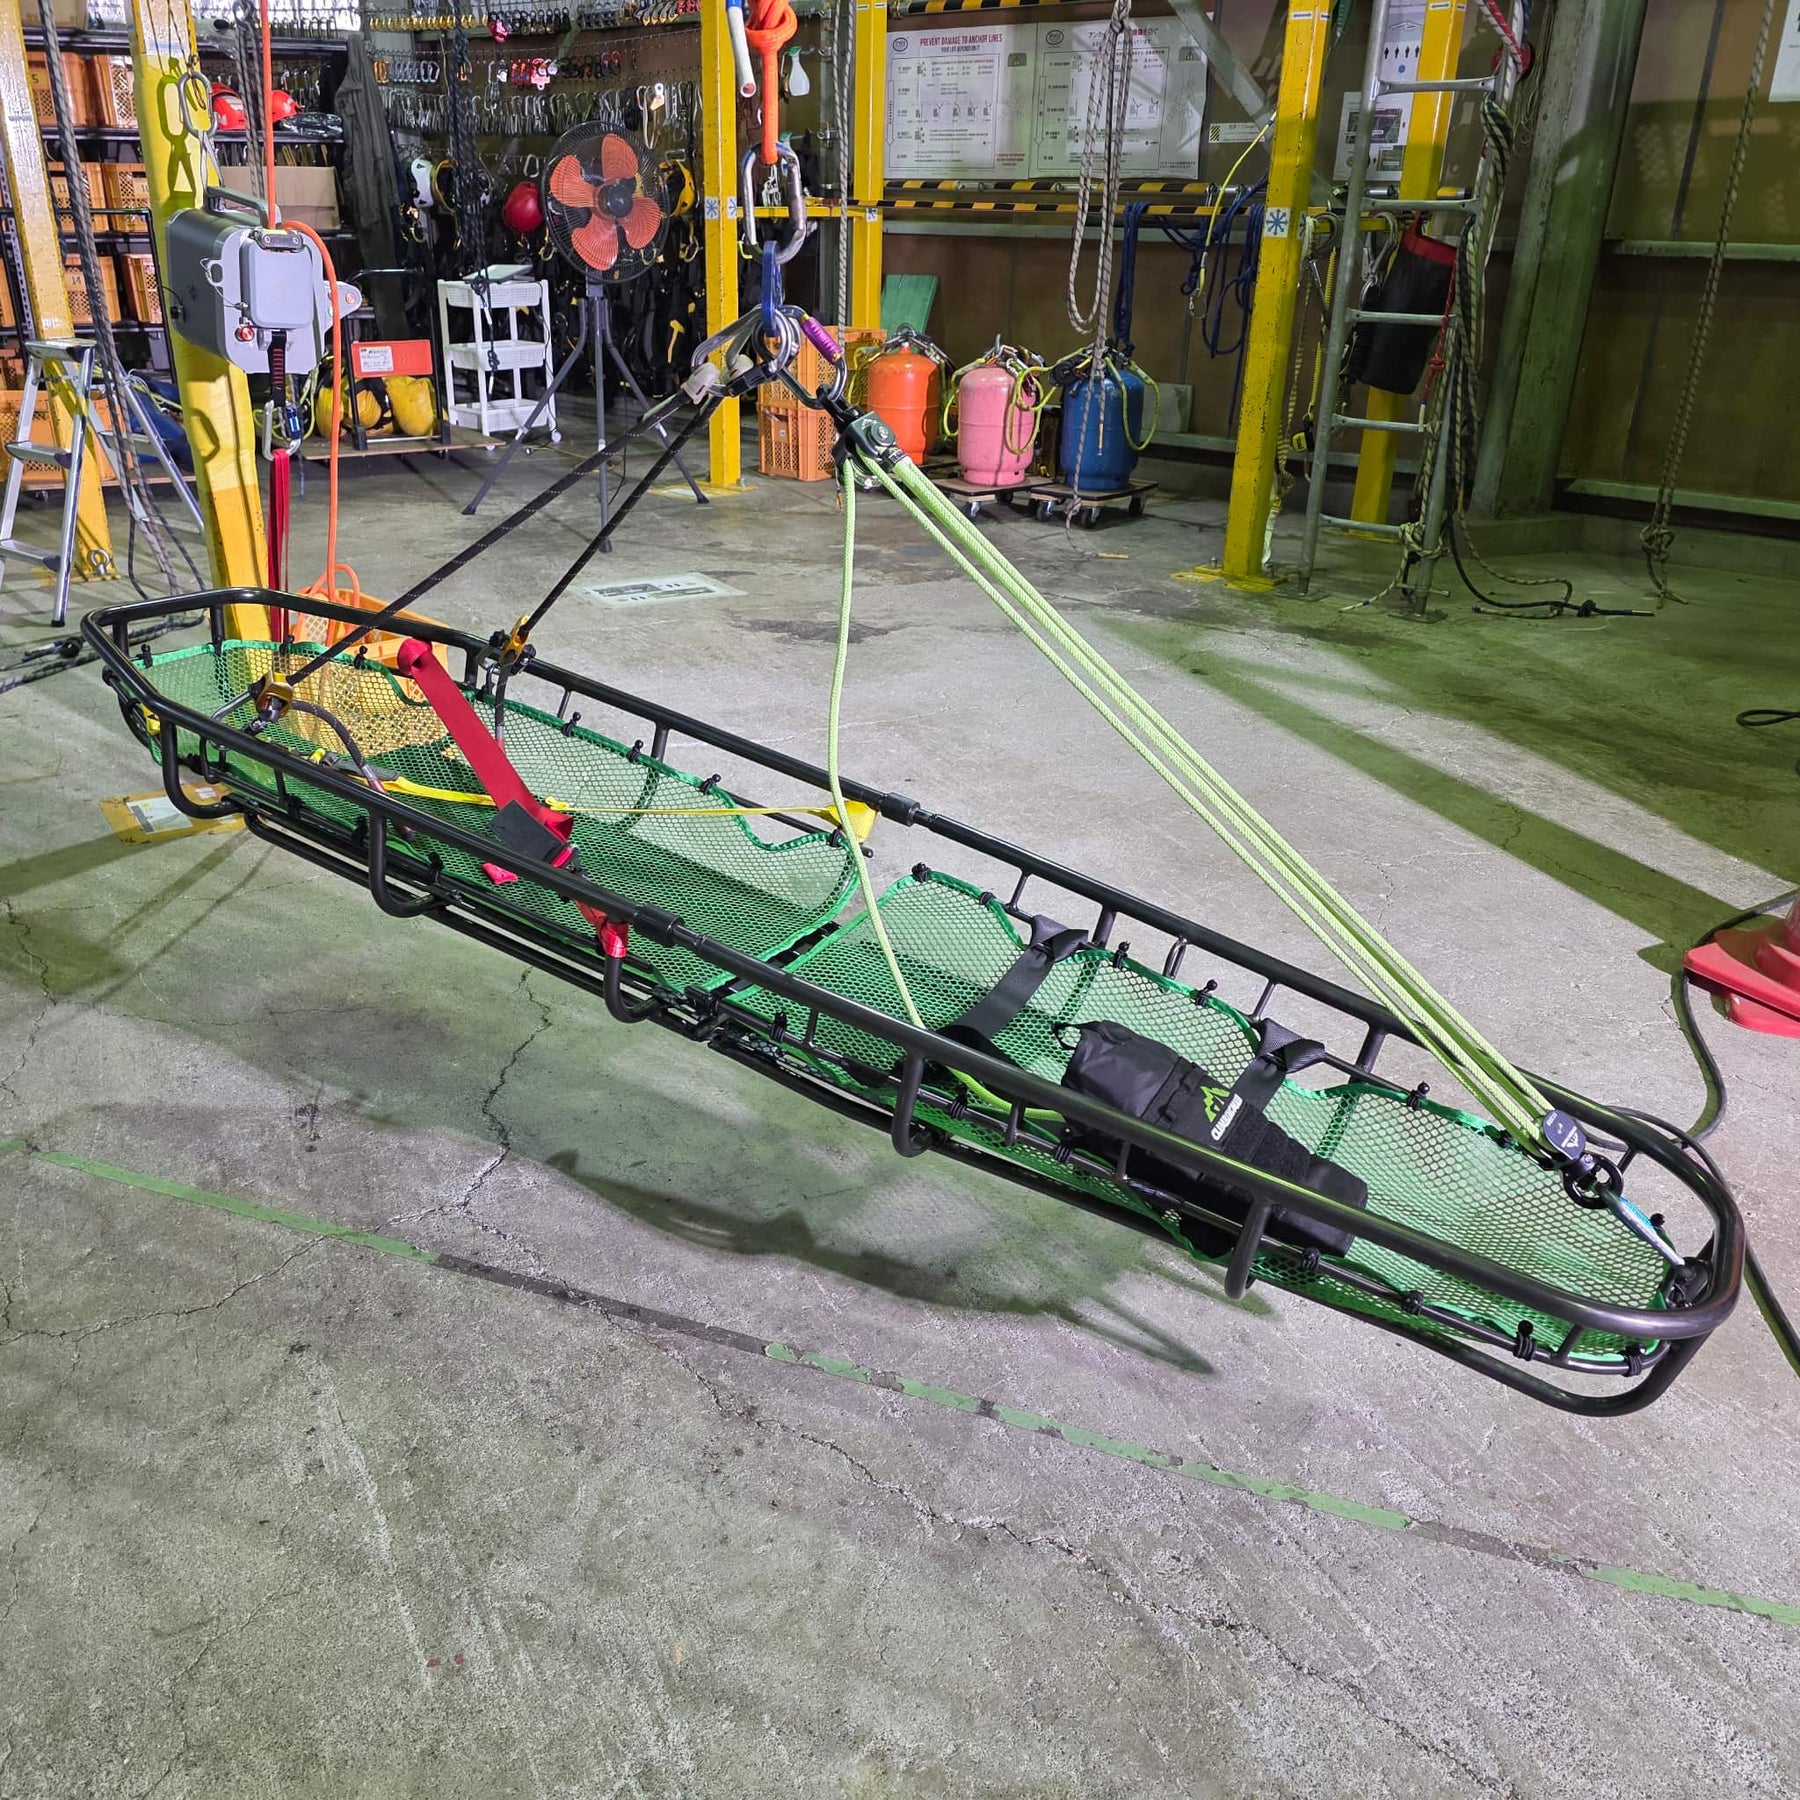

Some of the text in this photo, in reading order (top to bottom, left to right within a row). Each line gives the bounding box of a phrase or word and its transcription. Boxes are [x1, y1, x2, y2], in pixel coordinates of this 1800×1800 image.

[920, 33, 1003, 46] PREVENT DAMAGE TO ANCHOR LINES
[57, 183, 67, 193] 11
